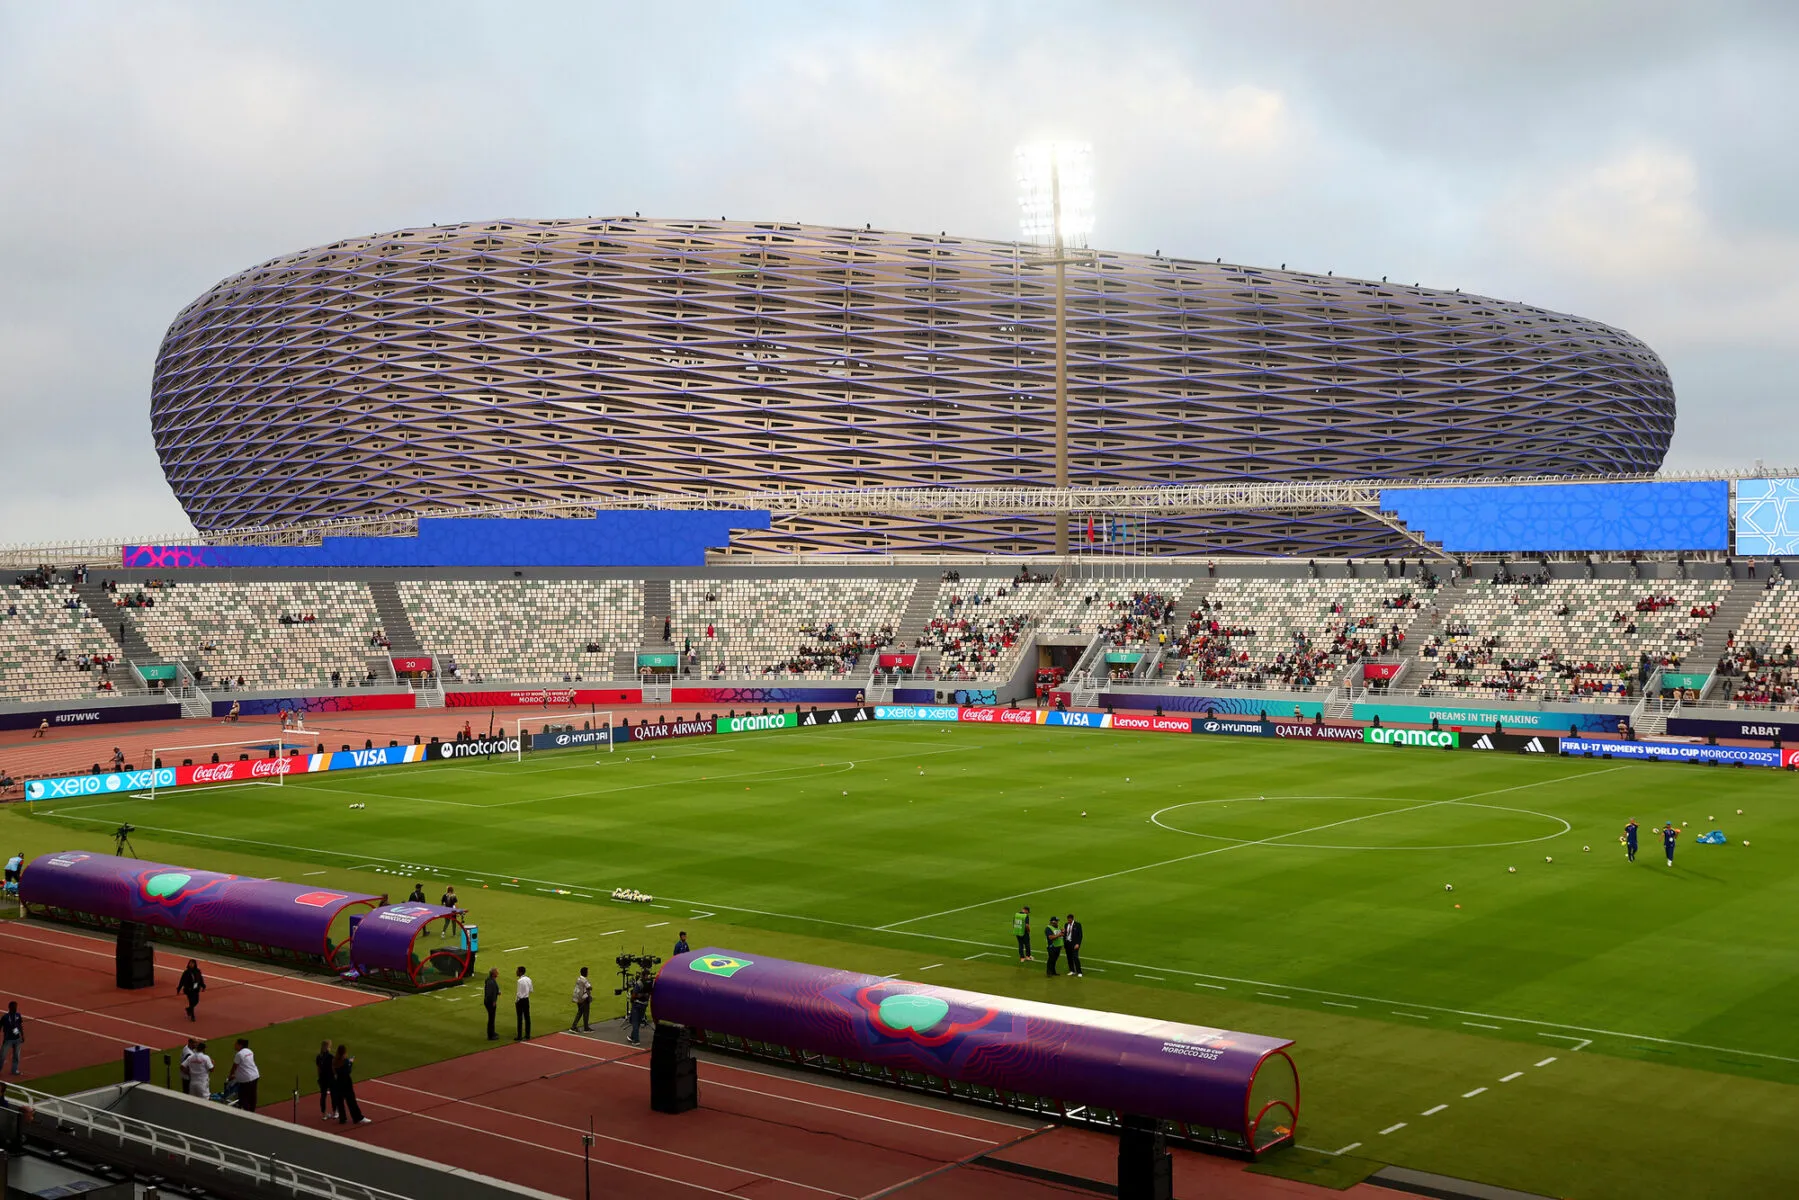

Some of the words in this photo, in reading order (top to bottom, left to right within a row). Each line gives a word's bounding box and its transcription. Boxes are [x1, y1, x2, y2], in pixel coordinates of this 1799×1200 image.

[1684, 678, 1692, 686] 15
[56, 712, 100, 722] #U17WWC
[888, 706, 916, 718] xero
[930, 707, 958, 719] xero
[1060, 712, 1090, 726] VISA
[1430, 711, 1466, 721] DREAMS
[1468, 713, 1478, 722] IN
[1480, 714, 1498, 722] THE
[731, 714, 785, 730] aramco
[1114, 716, 1149, 728] Lenovo
[1153, 718, 1190, 730] Lenovo
[1221, 724, 1262, 734] HYUNDAI
[572, 732, 608, 742] HYUNDAI
[634, 725, 668, 740] QATAR
[672, 720, 712, 734] AIRWAYS
[1276, 724, 1312, 738] QATAR
[1316, 728, 1364, 740] AIRWAYS
[1741, 726, 1781, 736] RABAT
[1370, 728, 1452, 747] aramco
[456, 740, 520, 757] motorola
[1562, 742, 1580, 750] FIFA
[1582, 743, 1600, 751] U-17
[1602, 744, 1644, 754] WOMEN'S
[1645, 746, 1679, 756] WORLD
[1680, 748, 1700, 757] CUP
[1700, 750, 1746, 760] MOROCCO
[350, 750, 388, 766] VISA
[192, 764, 234, 782] Coca-Cola
[50, 778, 100, 797] xero
[126, 770, 172, 788] xero
[1161, 1046, 1198, 1056] MOROCCO
[1198, 1052, 1218, 1060] 2025
